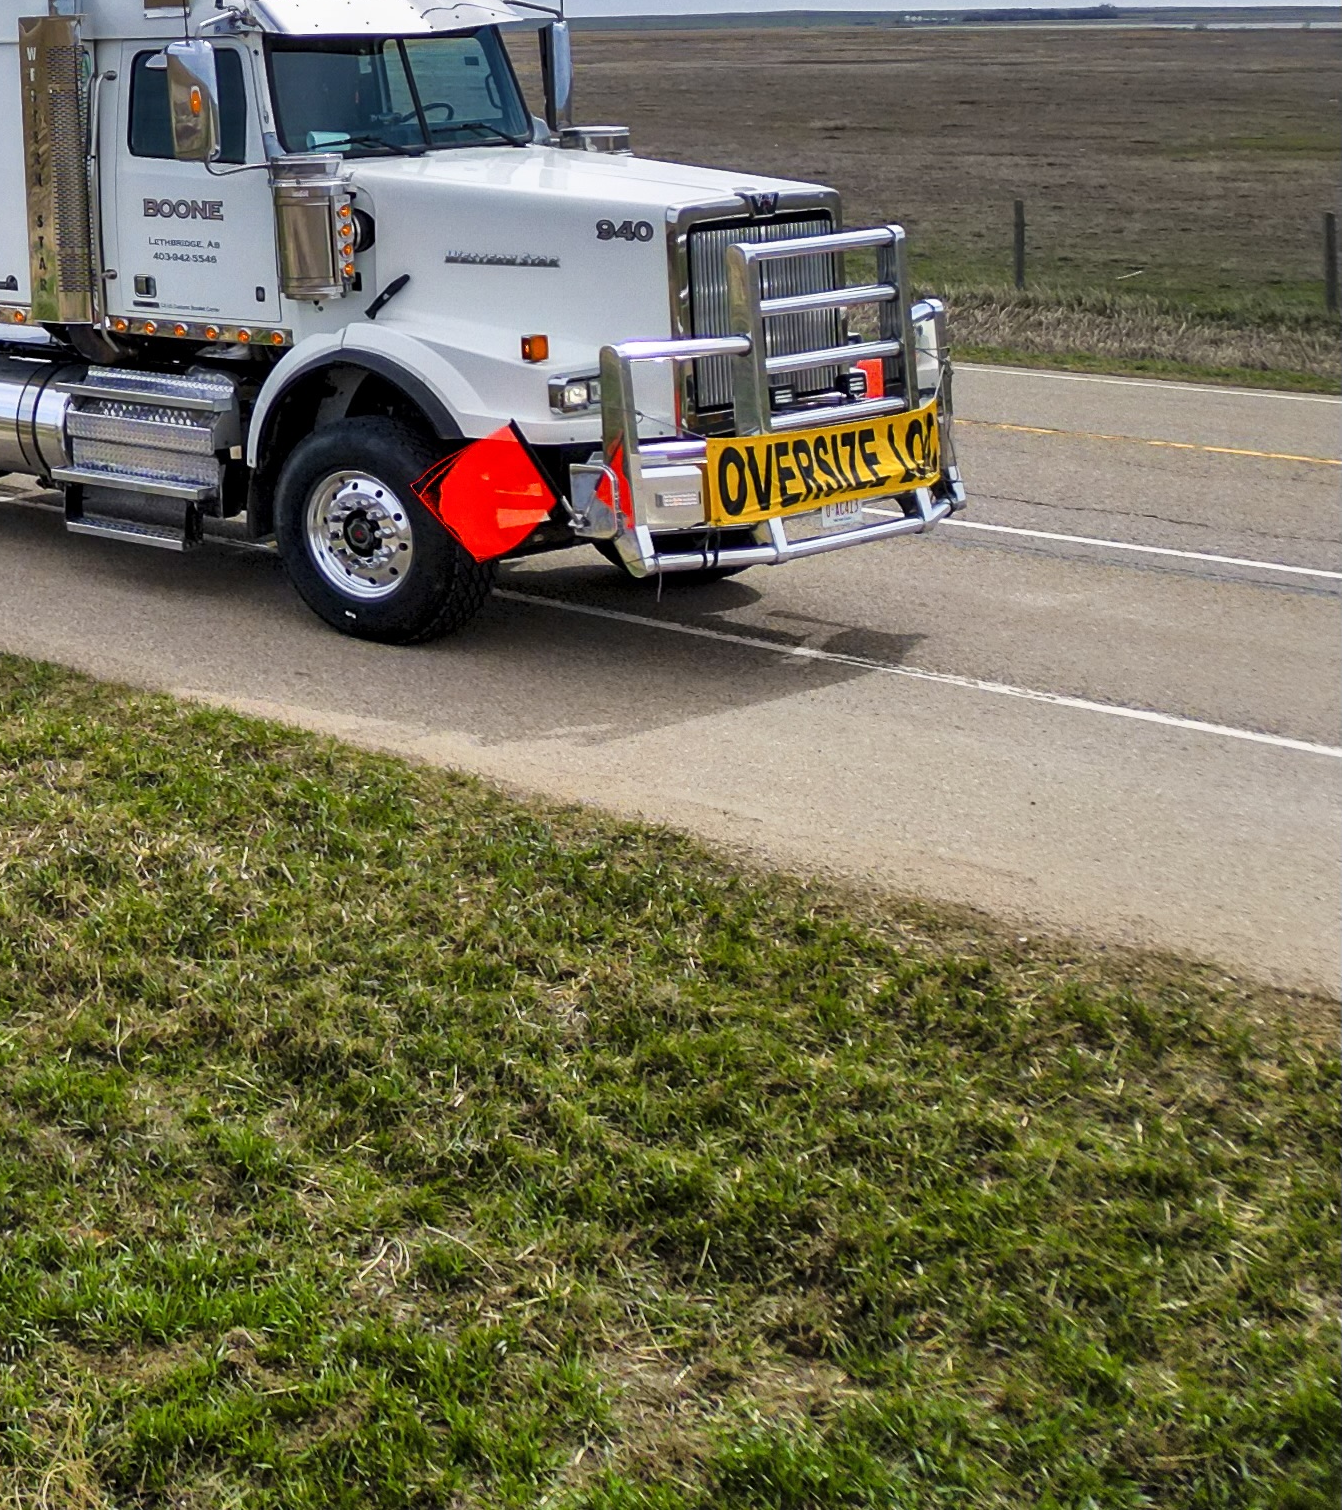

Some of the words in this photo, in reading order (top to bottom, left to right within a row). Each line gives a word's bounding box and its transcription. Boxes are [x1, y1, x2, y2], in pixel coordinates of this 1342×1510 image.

[143, 198, 224, 221] BOONE
[596, 219, 654, 242] 940
[36, 214, 48, 292] STAR
[718, 427, 891, 516] OVERSIZE
